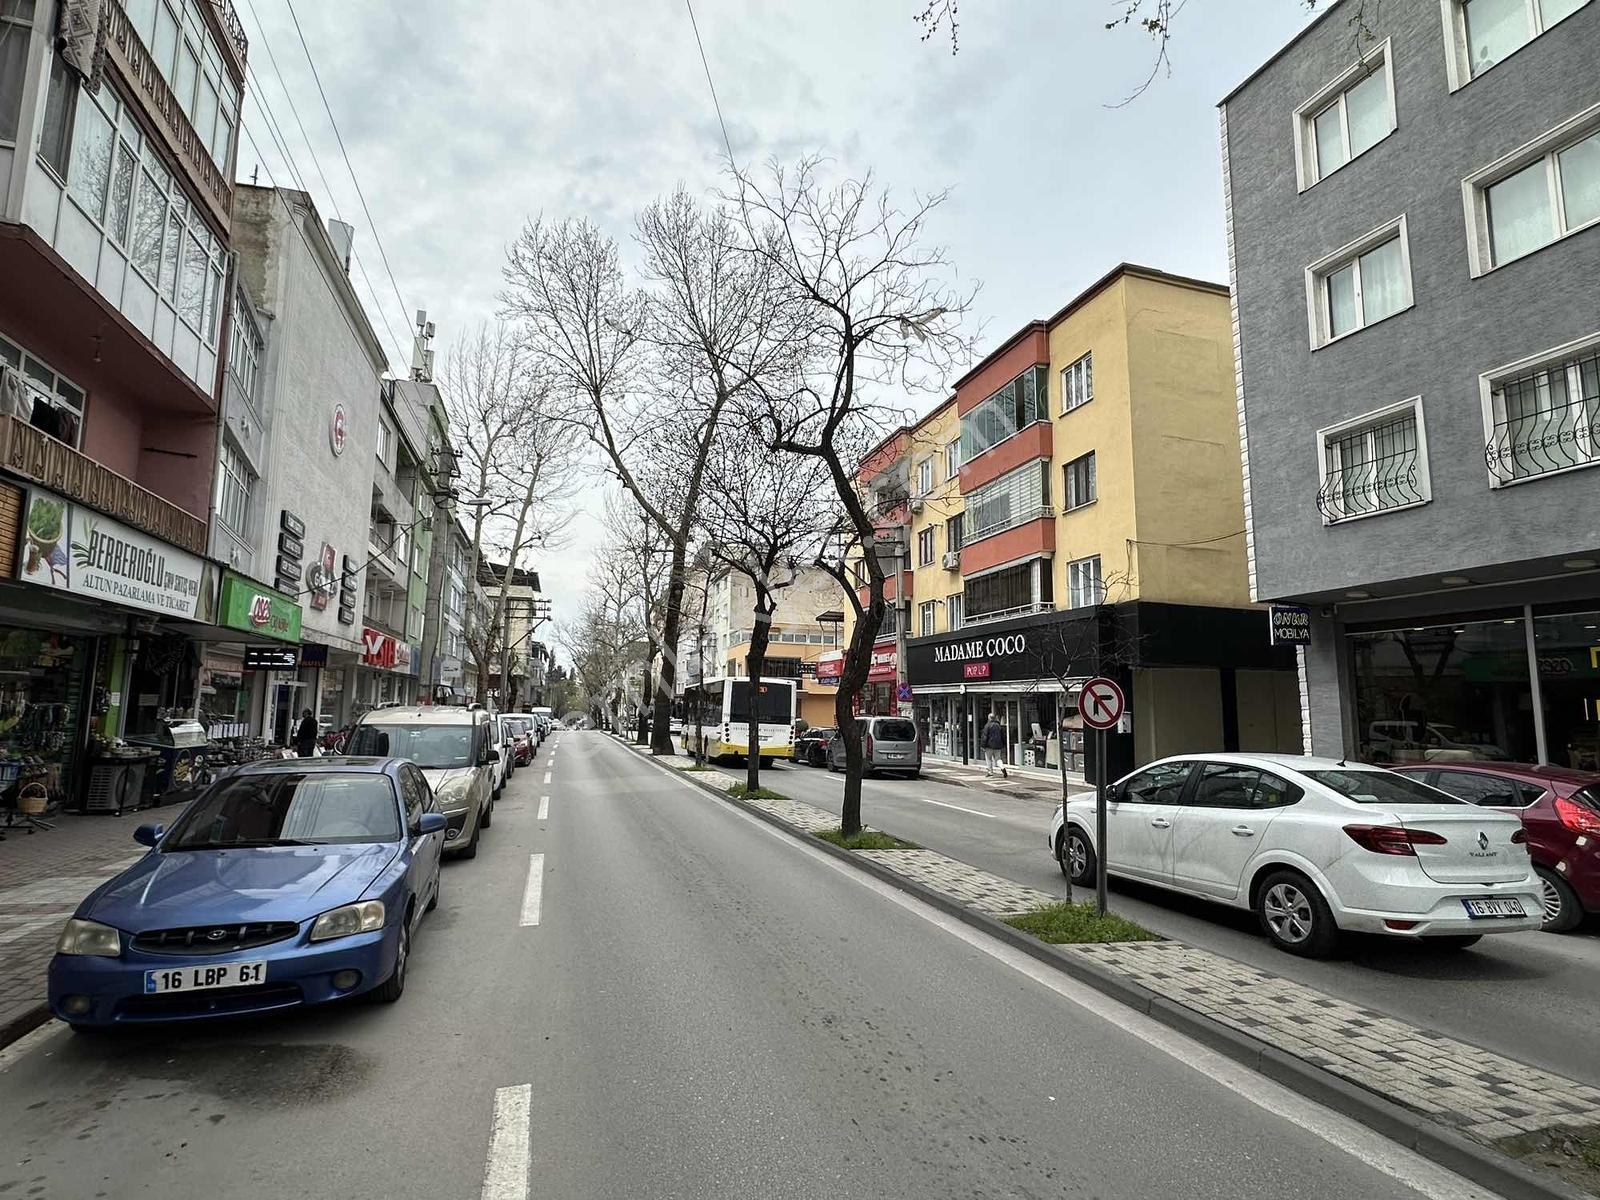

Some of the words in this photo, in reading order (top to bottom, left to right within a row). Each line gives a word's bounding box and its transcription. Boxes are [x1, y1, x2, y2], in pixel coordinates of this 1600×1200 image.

[87, 529, 165, 588] BERBEROĞLU
[82, 573, 113, 594] ALTUN
[113, 581, 155, 605] PAZARLAMA
[156, 593, 165, 607] VE
[165, 594, 190, 612] TİCARET
[934, 641, 984, 663] MADAME
[986, 634, 1026, 657] COCO
[1471, 901, 1485, 914] 16
[1485, 900, 1503, 914] BVY
[1503, 900, 1522, 913] 040
[162, 971, 183, 989] 16
[193, 967, 227, 987] LBP
